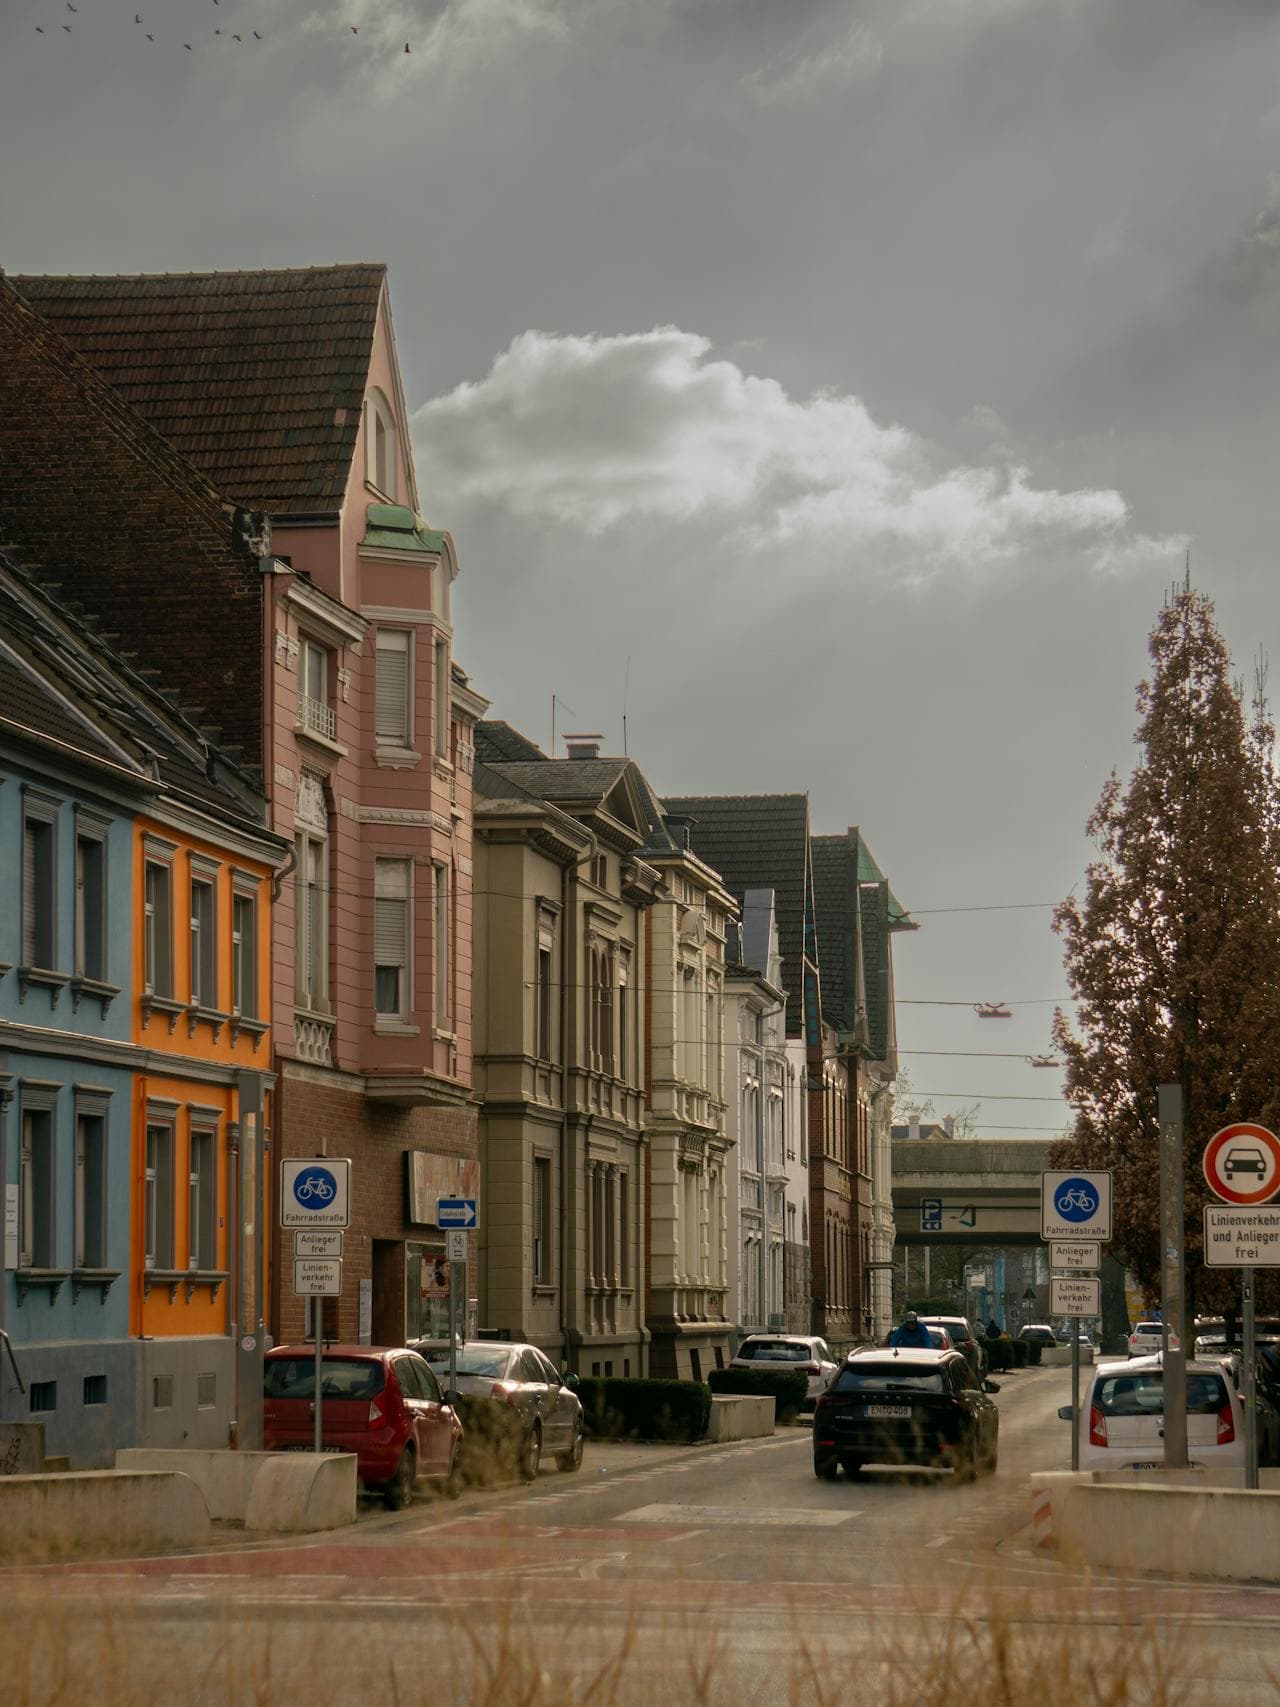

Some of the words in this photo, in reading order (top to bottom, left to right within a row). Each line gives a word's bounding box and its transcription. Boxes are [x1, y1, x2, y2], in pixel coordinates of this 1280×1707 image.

[925, 1201, 940, 1219] P
[286, 1213, 344, 1222] Fahrradstraße
[1211, 1214, 1280, 1226] Linienverkehr
[1046, 1225, 1107, 1235] Fahrradstraße
[301, 1235, 336, 1244] Anlieger
[1213, 1230, 1231, 1242] und
[1237, 1230, 1279, 1244] Anlieger
[311, 1244, 326, 1253] frei
[1056, 1246, 1093, 1256] Anlieger
[1235, 1246, 1258, 1258] frei
[1067, 1256, 1083, 1265] frei
[303, 1263, 333, 1272] Linien-
[301, 1272, 334, 1281] verkehr
[310, 1282, 325, 1291] frei
[1059, 1283, 1091, 1292] Linien-
[1057, 1293, 1093, 1302] verkehr
[1067, 1303, 1083, 1312] frei
